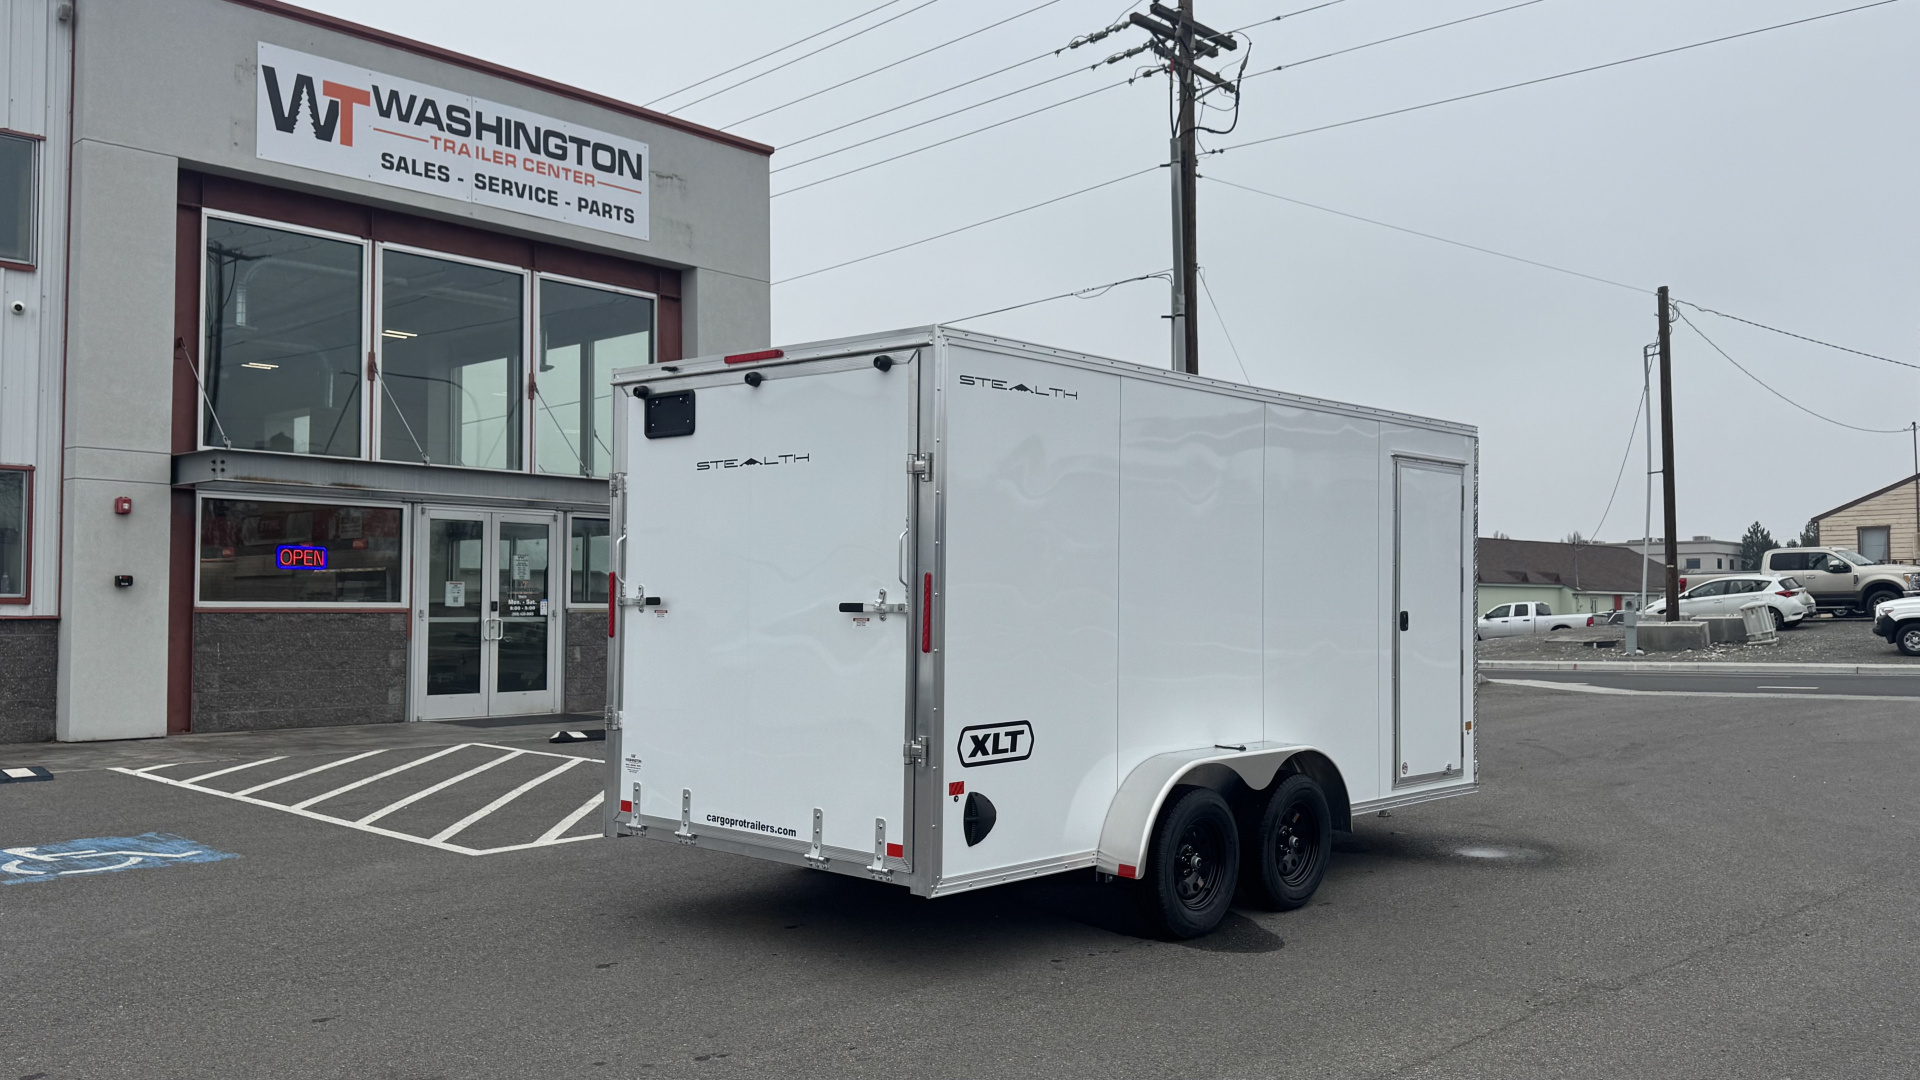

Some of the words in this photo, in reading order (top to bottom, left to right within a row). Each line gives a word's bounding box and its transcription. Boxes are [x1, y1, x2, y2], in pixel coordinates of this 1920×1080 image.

[261, 64, 371, 147] WT
[371, 84, 643, 181] WASHINGTON
[430, 135, 517, 168] TRAILER
[522, 157, 596, 187] CENTER
[380, 152, 450, 183] SALES
[474, 172, 559, 206] SERVICE
[577, 197, 635, 224] PARTS
[959, 374, 1078, 400] STEALTH
[696, 453, 810, 471] STEALTH
[279, 548, 325, 566] OPEN
[967, 729, 1025, 758] XLT
[706, 813, 797, 837] cargoprotrailers.com
